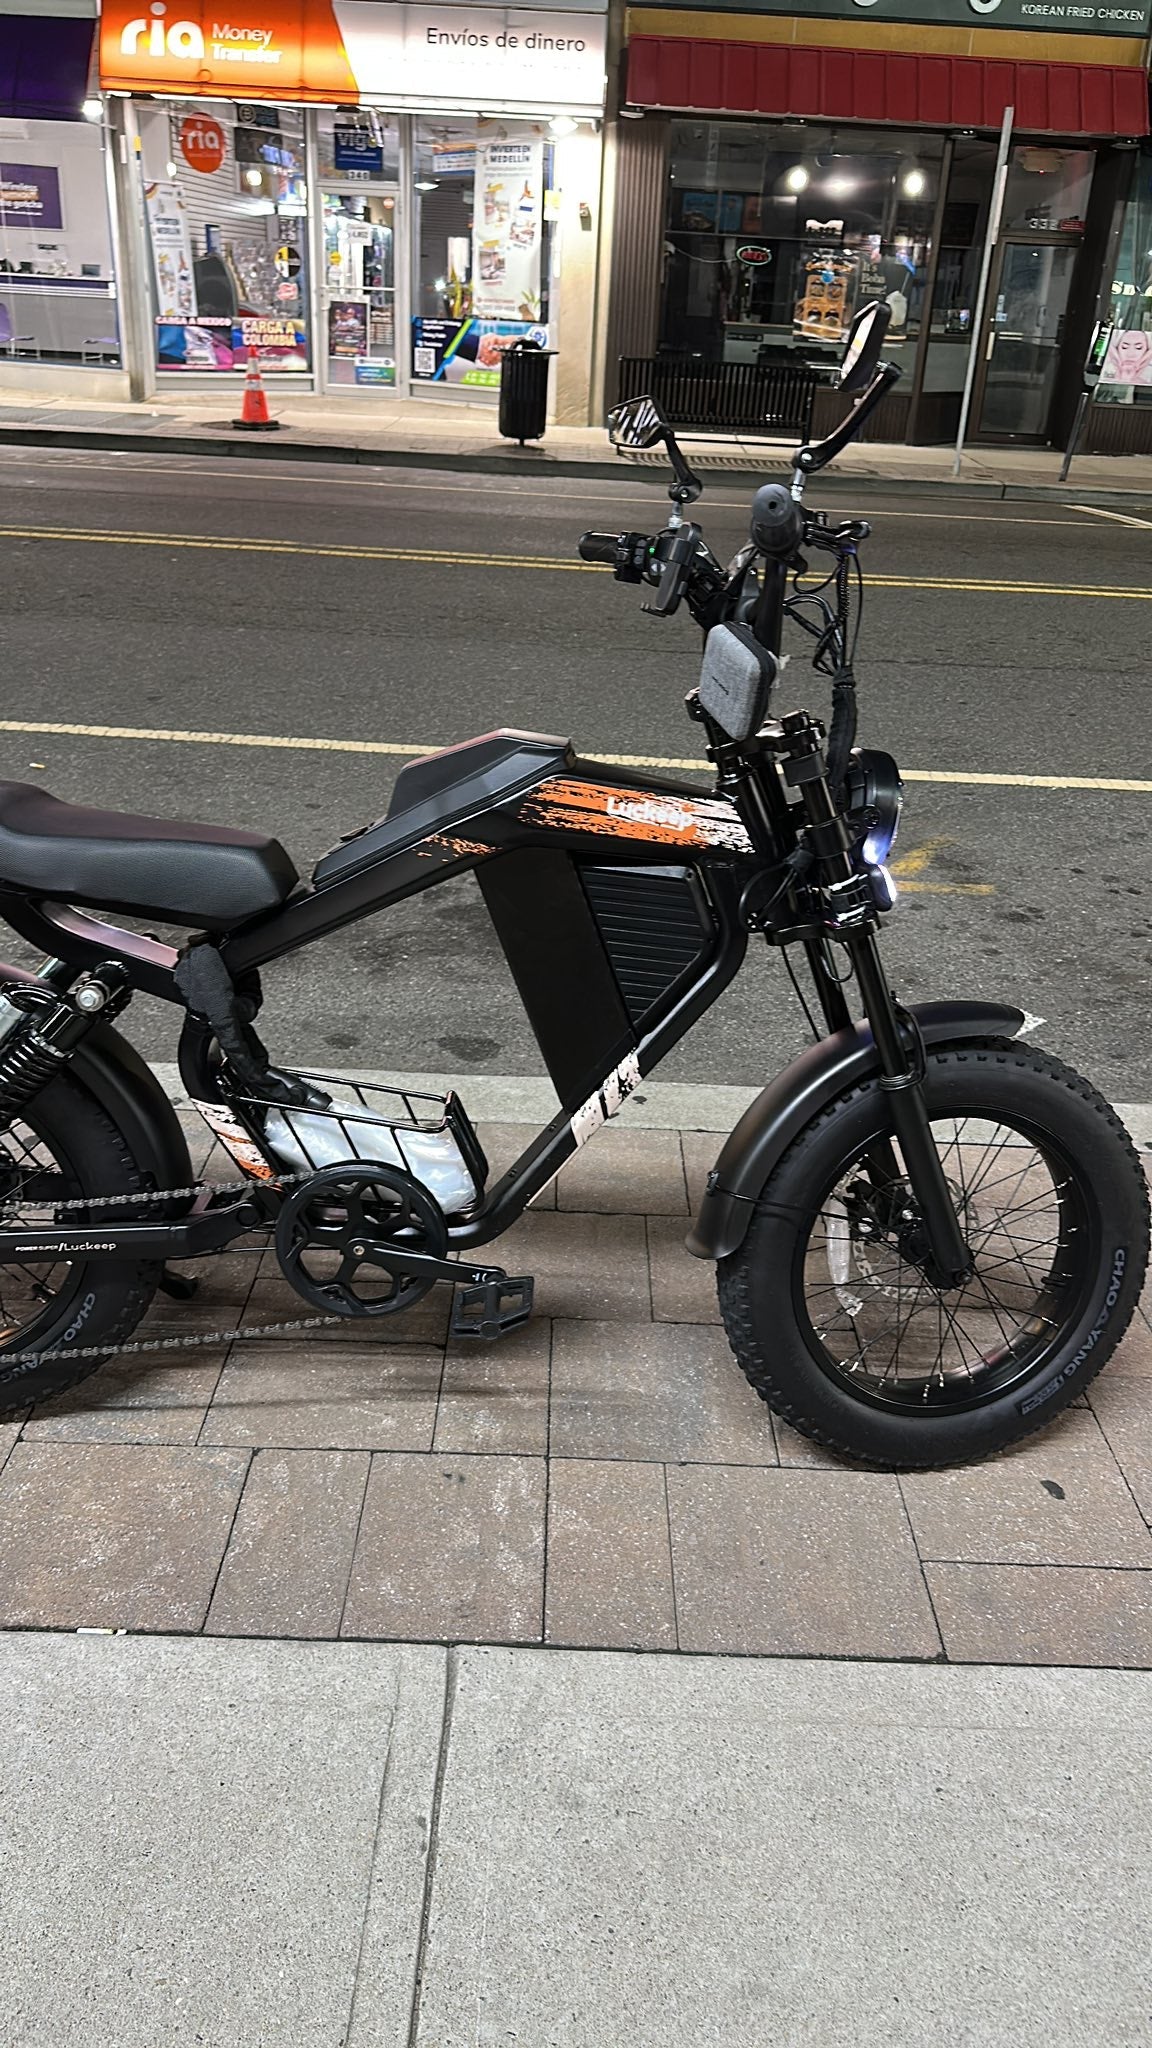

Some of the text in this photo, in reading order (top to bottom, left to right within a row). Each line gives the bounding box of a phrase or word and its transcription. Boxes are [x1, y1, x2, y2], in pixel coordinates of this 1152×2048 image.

[1021, 4, 1145, 20] KOREAN FRIED CHICKEN
[120, 2, 205, 59] ria
[212, 23, 273, 46] Money
[426, 27, 586, 52] Envíos de dinero
[210, 43, 283, 64] Transfer
[187, 121, 219, 150] ria
[242, 320, 296, 334] CARGA A
[242, 333, 297, 347] COLOMBIA
[606, 795, 694, 832] Luckeep
[63, 1292, 96, 1341] CHAO
[1063, 1248, 1126, 1377] CHAO YANG
